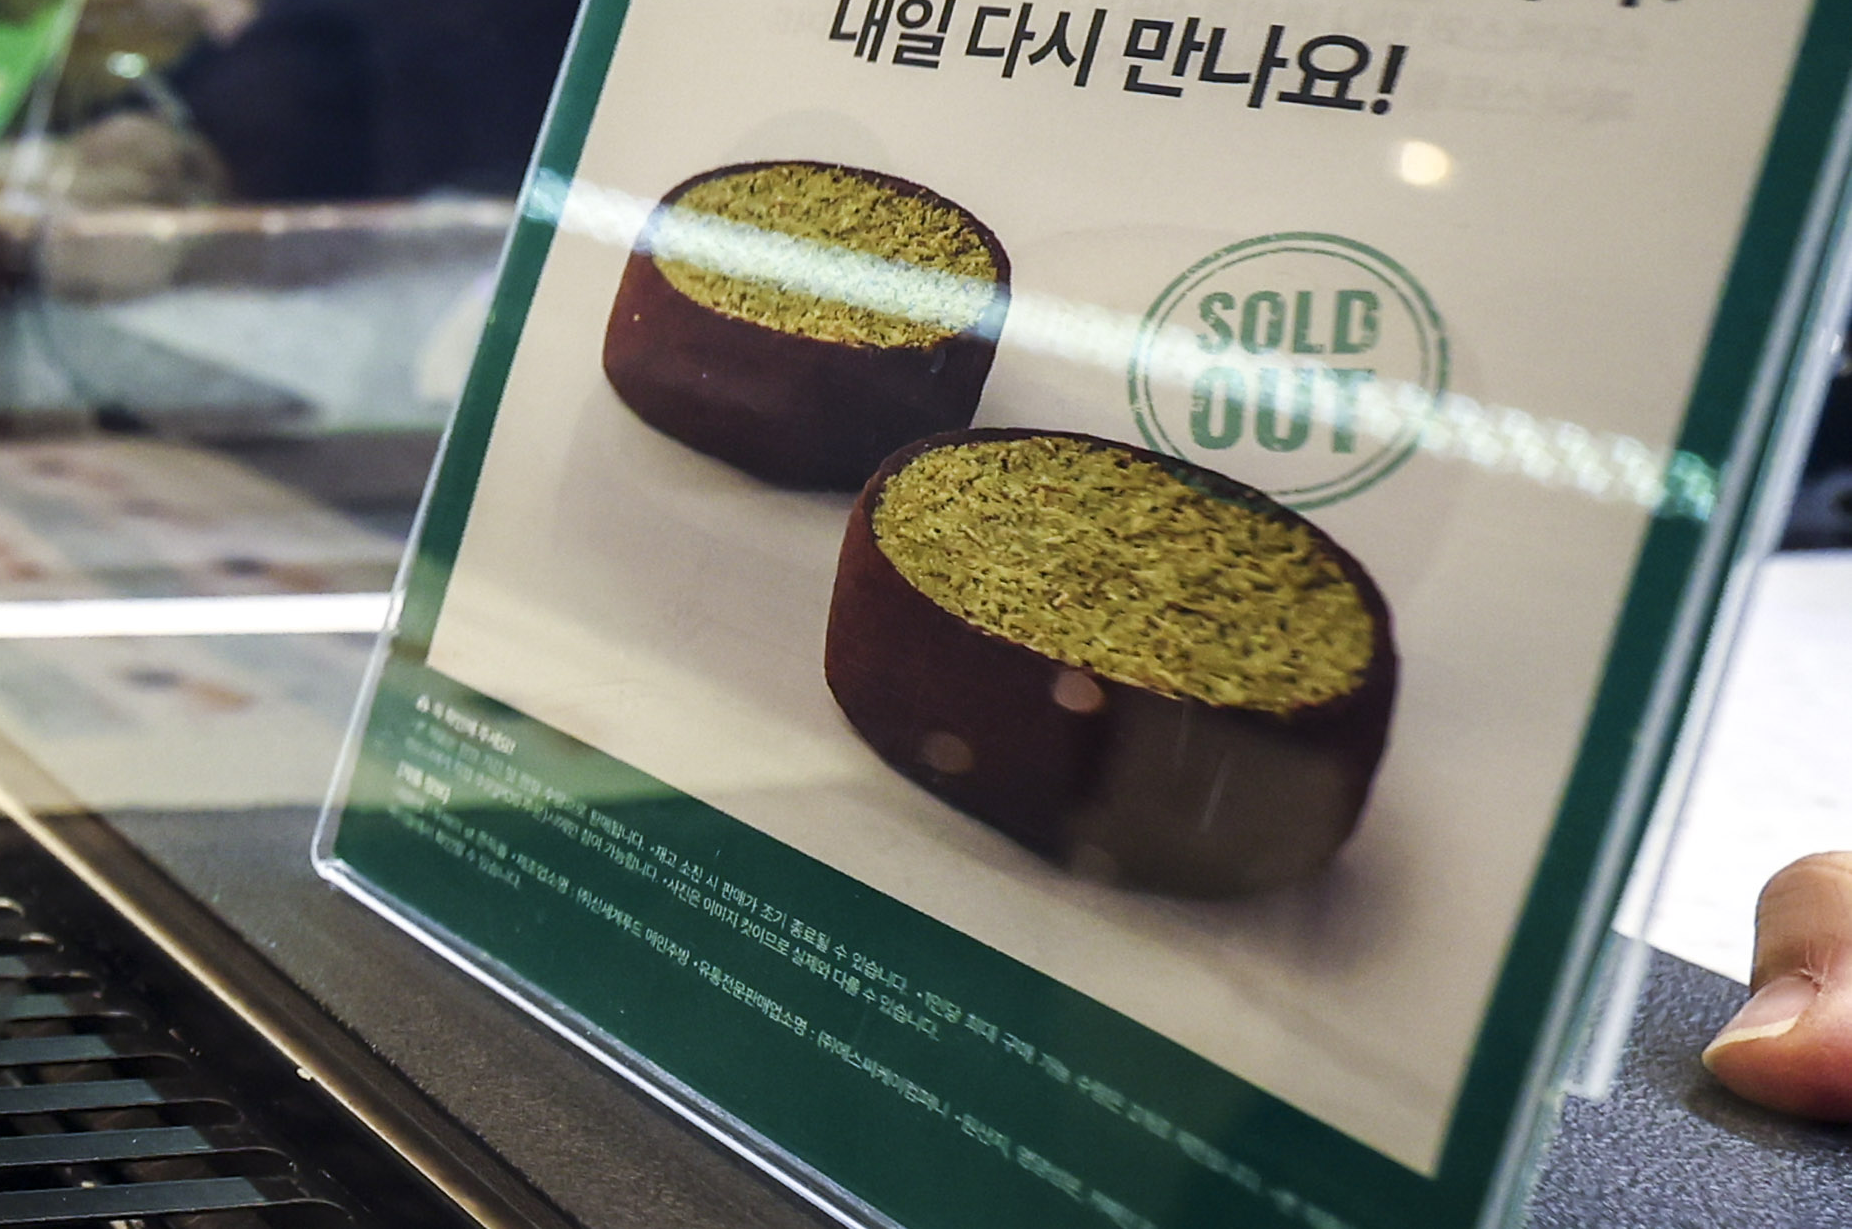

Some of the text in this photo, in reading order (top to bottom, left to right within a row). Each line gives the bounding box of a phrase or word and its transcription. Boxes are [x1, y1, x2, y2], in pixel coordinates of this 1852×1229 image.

[966, 3, 1107, 87] 다시
[1123, 17, 1407, 115] 만나요!
[1196, 289, 1381, 355] SOLD
[1189, 367, 1377, 454] OUT
[666, 878, 700, 908] 사진은
[702, 897, 739, 928] 이미지
[740, 917, 789, 956] 컷이므로
[861, 987, 876, 1003] 수
[678, 859, 703, 883] 소진
[705, 874, 719, 891] 시
[721, 881, 757, 913] 판매가
[759, 902, 787, 929] 조기
[790, 918, 830, 953] 종료될
[832, 943, 847, 960] 수
[850, 951, 909, 994] 있습니다.
